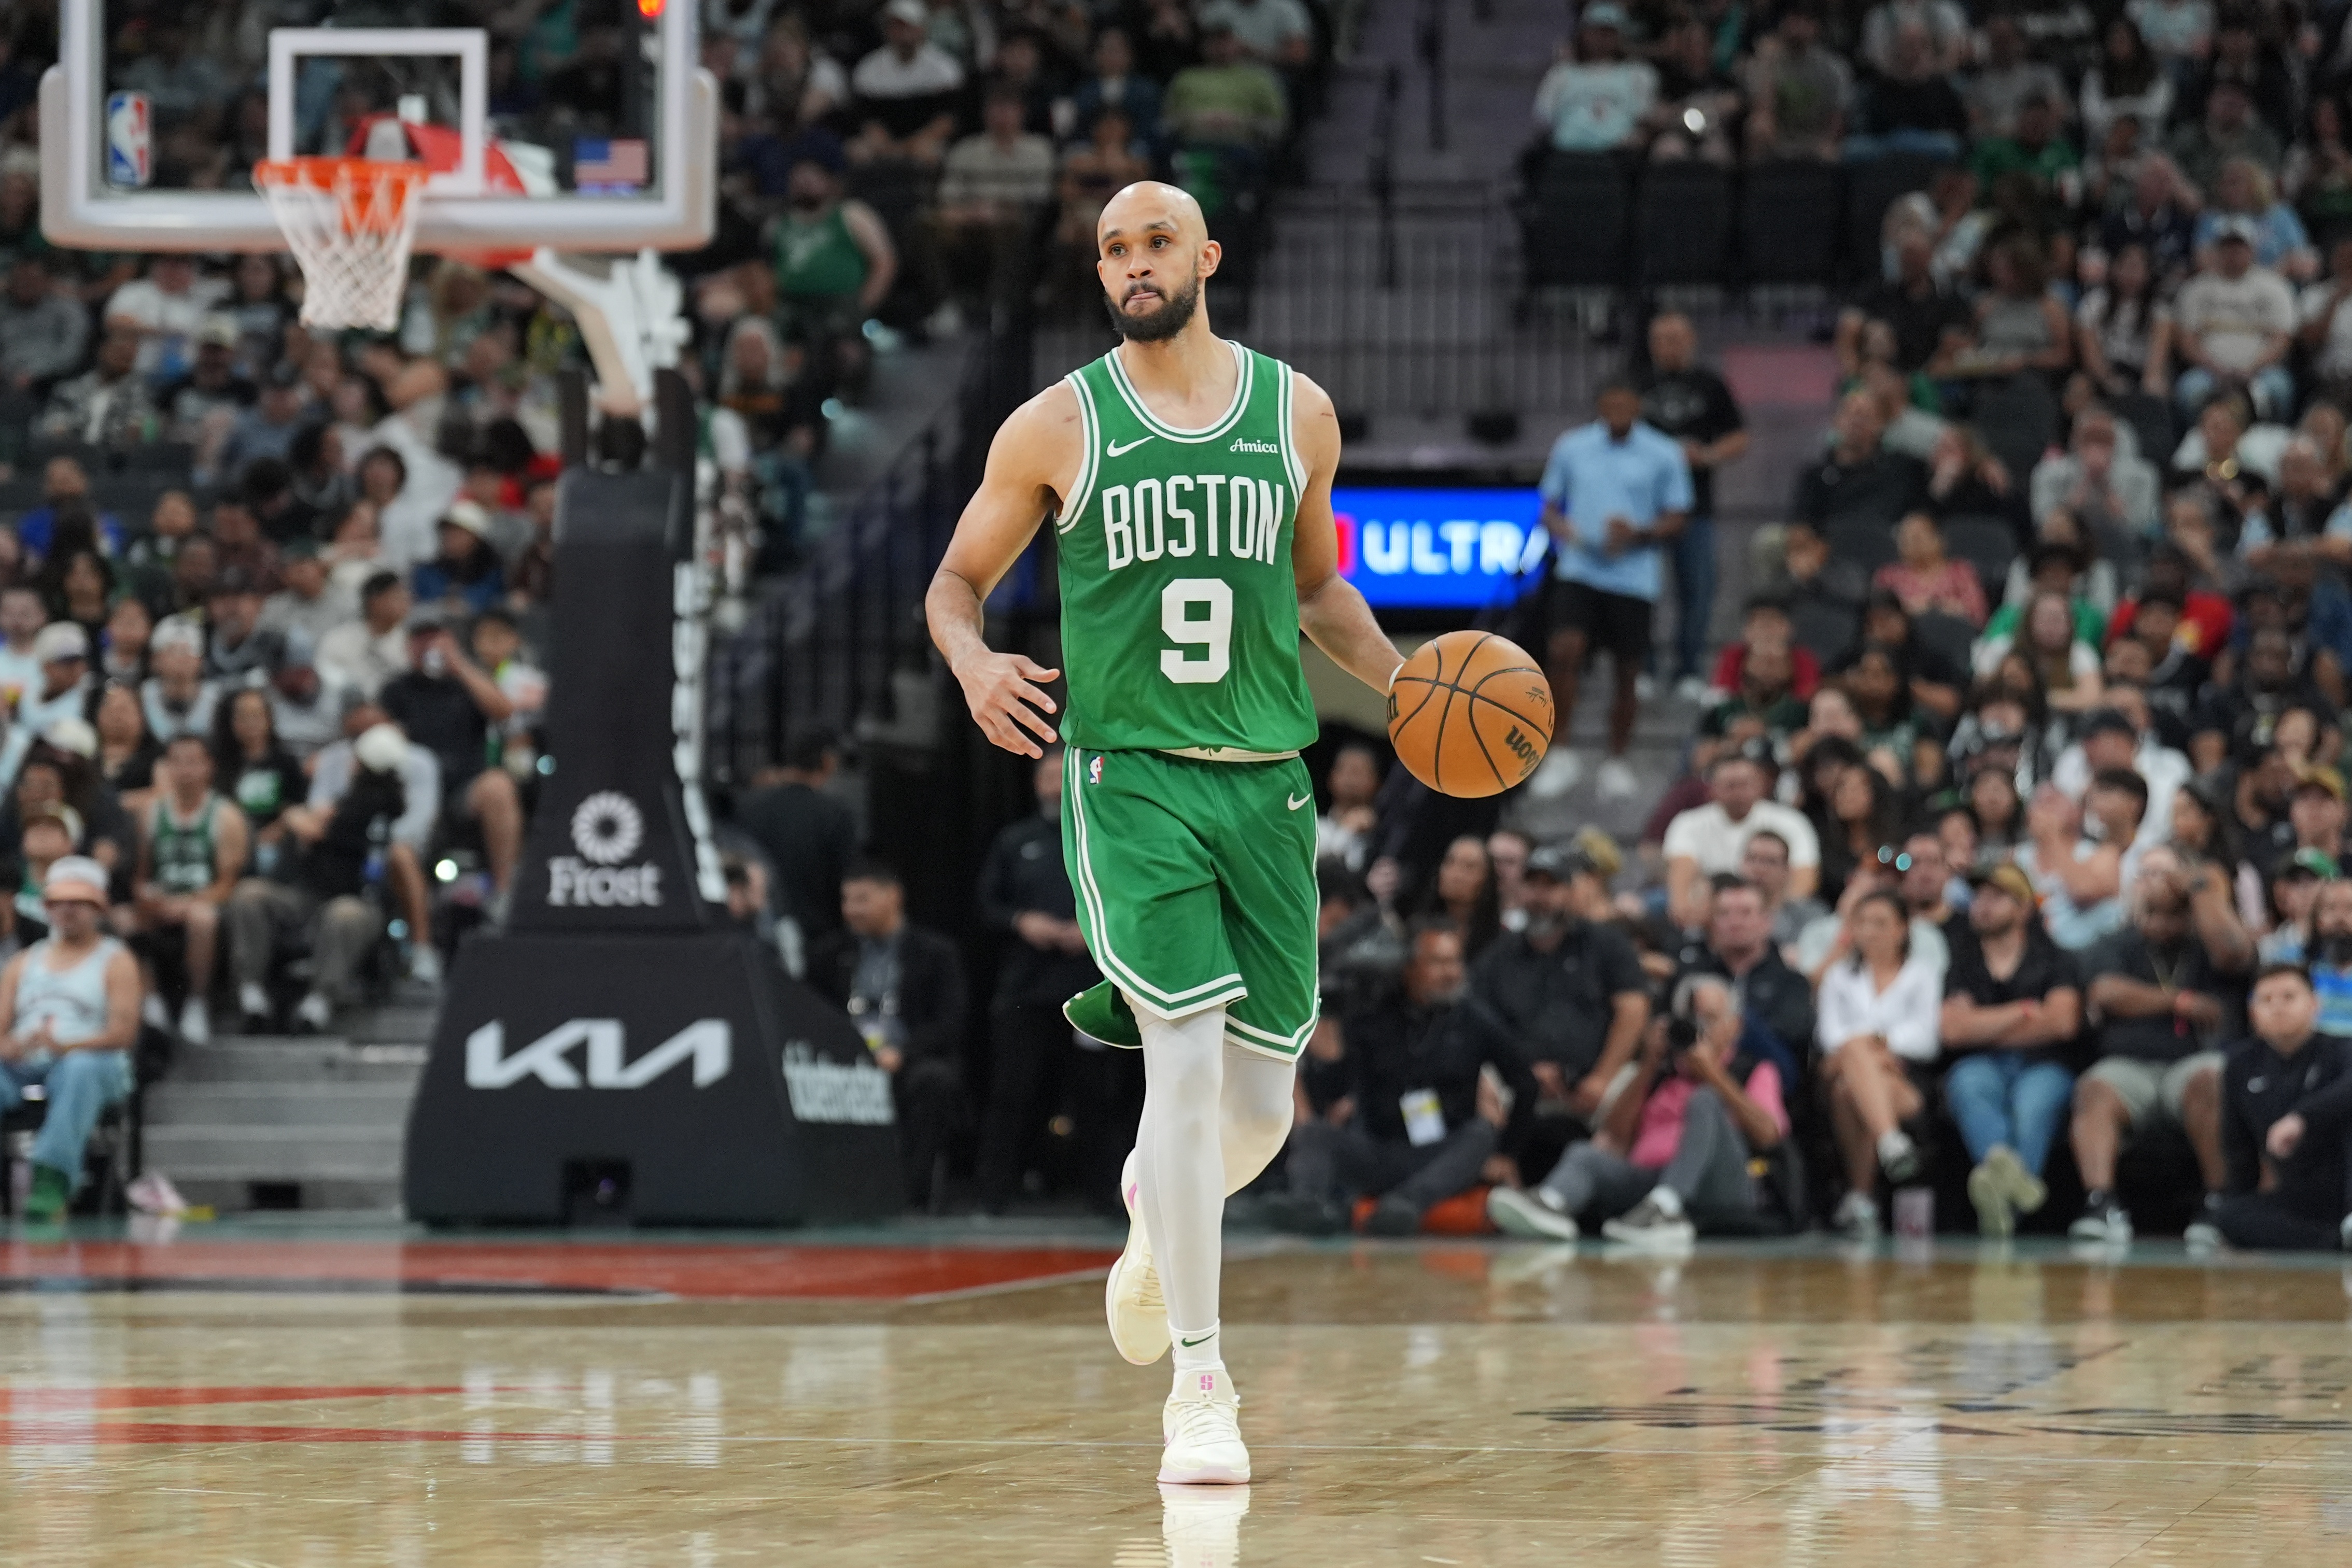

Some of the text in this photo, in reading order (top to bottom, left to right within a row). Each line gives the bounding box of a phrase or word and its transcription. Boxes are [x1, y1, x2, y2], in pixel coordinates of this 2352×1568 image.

[1230, 437, 1278, 454] Amica
[1102, 474, 1284, 571] BOSTON
[1160, 578, 1233, 684] 9
[546, 856, 663, 906] Frost
[465, 1018, 733, 1089] KIA
